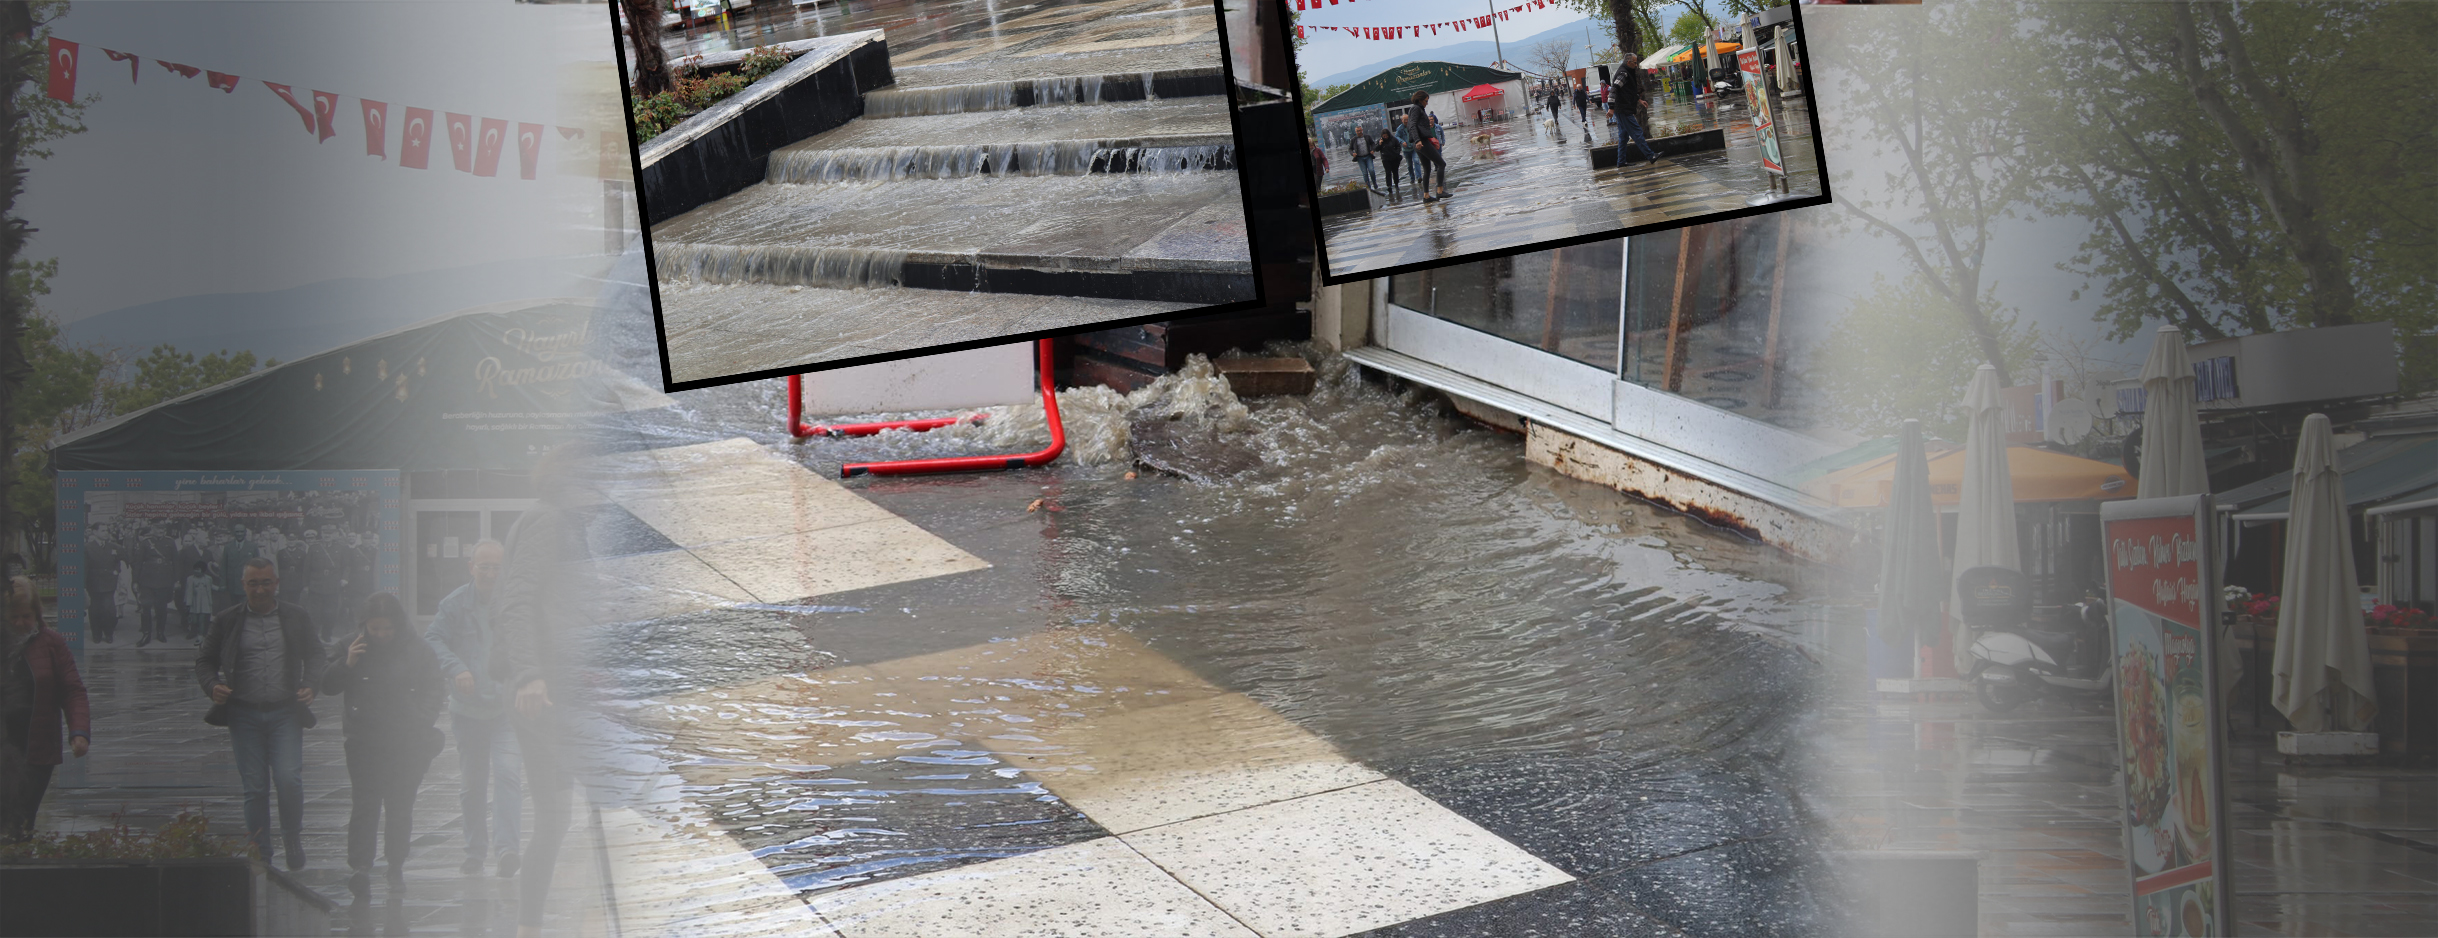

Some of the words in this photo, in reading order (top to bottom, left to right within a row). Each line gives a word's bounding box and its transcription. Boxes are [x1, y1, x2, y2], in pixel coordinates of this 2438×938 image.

[174, 478, 197, 490] yine
[200, 475, 246, 485] baharlar
[2164, 632, 2196, 666] Magnolya
